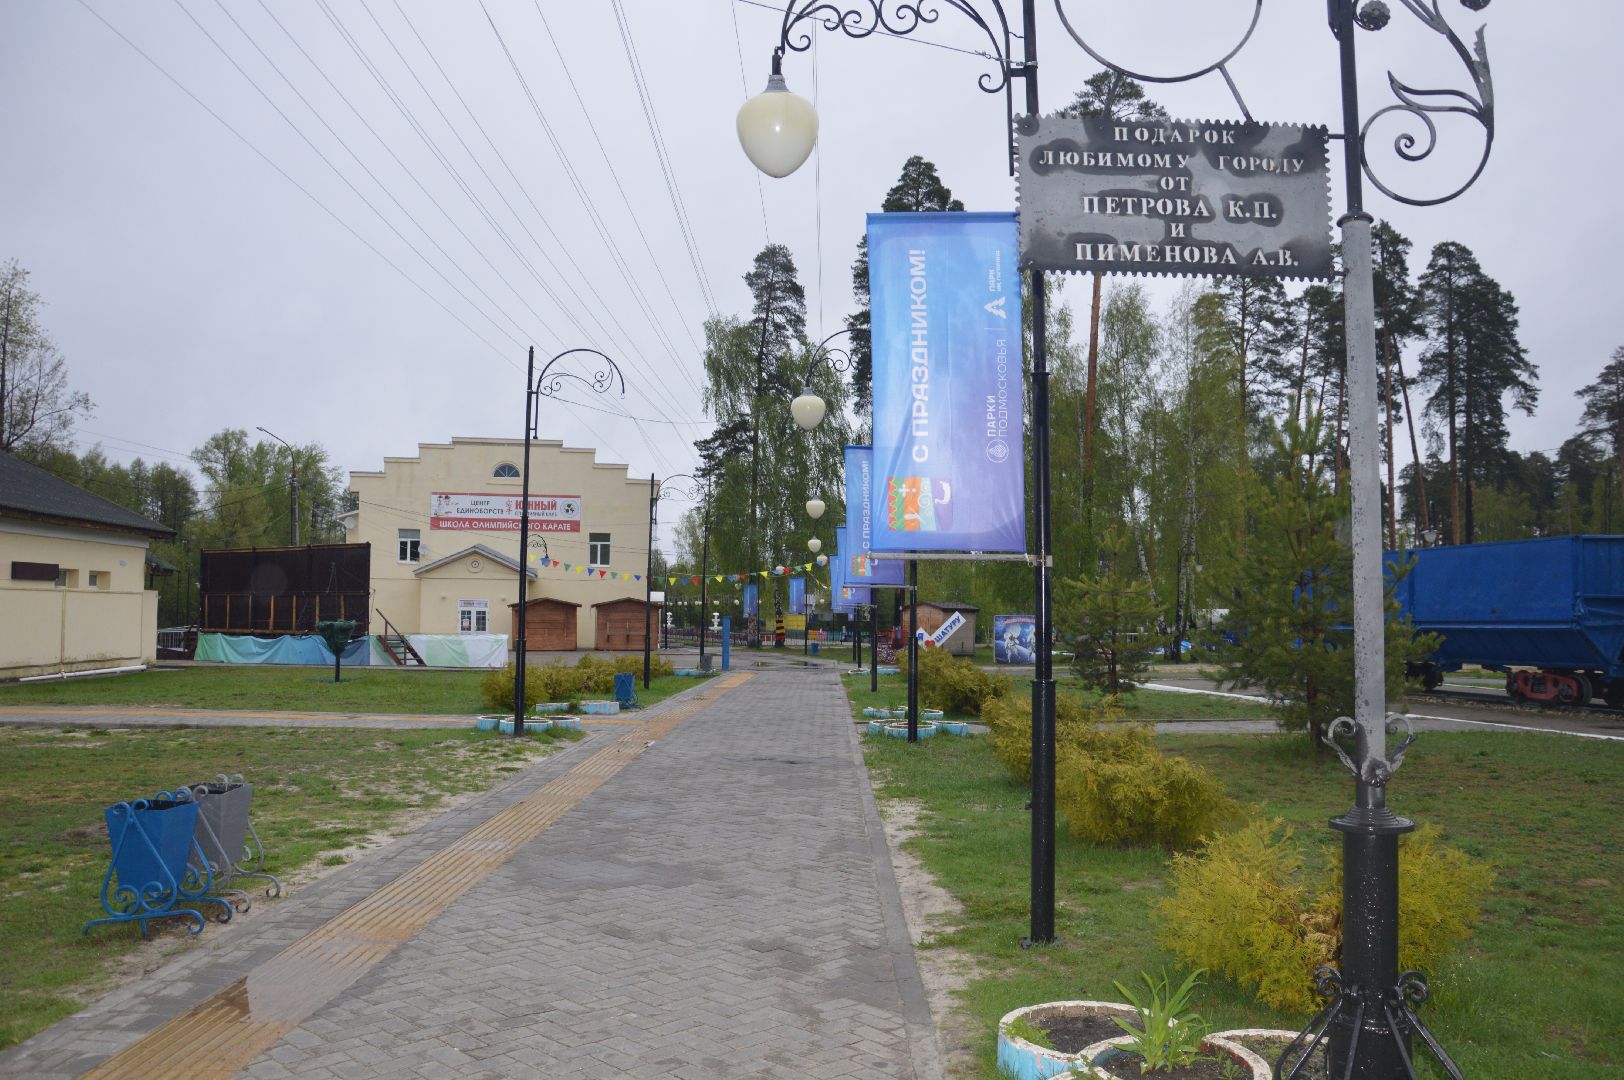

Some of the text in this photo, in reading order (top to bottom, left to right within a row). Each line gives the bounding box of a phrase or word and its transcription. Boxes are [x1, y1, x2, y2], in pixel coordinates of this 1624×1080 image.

[1113, 126, 1235, 145] ПОДАРОК
[1039, 150, 1304, 174] ЛЮБИМОМУ ГОРОДУ
[1160, 176, 1189, 191] ОТ
[1083, 196, 1278, 219] ПЕТРОВА К.П.
[1170, 222, 1185, 238] И
[1075, 242, 1299, 267] ПИМЕНОВА А.В.
[909, 249, 929, 464] С ПРАЗДНИКОМ!
[998, 339, 1008, 437] ПОДМОСКОВЬЯ
[987, 395, 997, 437] ПАРКИ
[456, 508, 504, 516] ЕДИНОБОРСТВ
[861, 460, 870, 549] С ПРАЗДНИКОМ!
[439, 520, 470, 529] ШКОЛА
[542, 522, 572, 531] КАРАТЕ
[917, 615, 961, 643] Я ШАТУРУ
